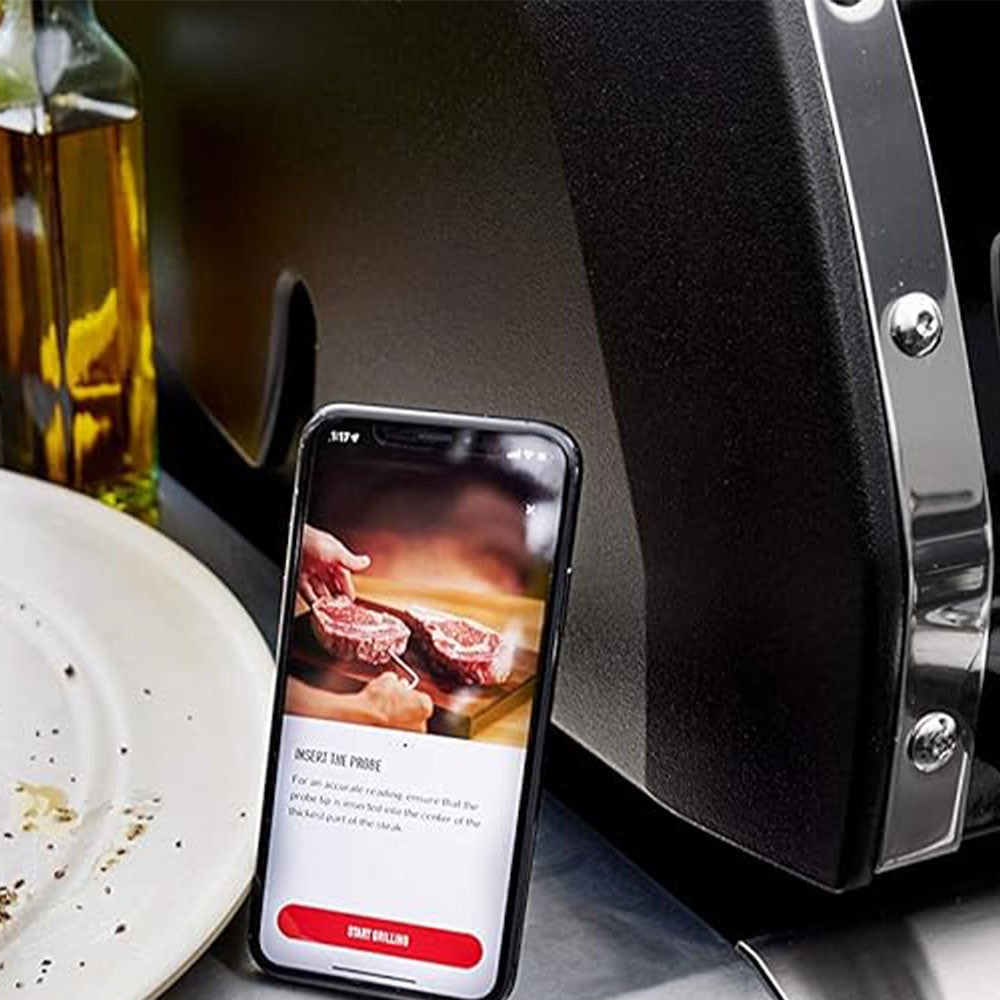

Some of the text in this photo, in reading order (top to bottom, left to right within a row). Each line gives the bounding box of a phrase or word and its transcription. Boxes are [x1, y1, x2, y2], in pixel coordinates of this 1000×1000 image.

[294, 747, 382, 773] INSERT THE PROBE
[292, 774, 308, 785] For
[324, 780, 363, 793] accurate
[442, 797, 461, 808] that
[463, 801, 479, 811] the
[290, 792, 317, 802] probe
[404, 808, 419, 818] the
[466, 817, 481, 828] the
[326, 814, 346, 823] part
[359, 817, 374, 828] the
[347, 925, 409, 948] START GRILLING
